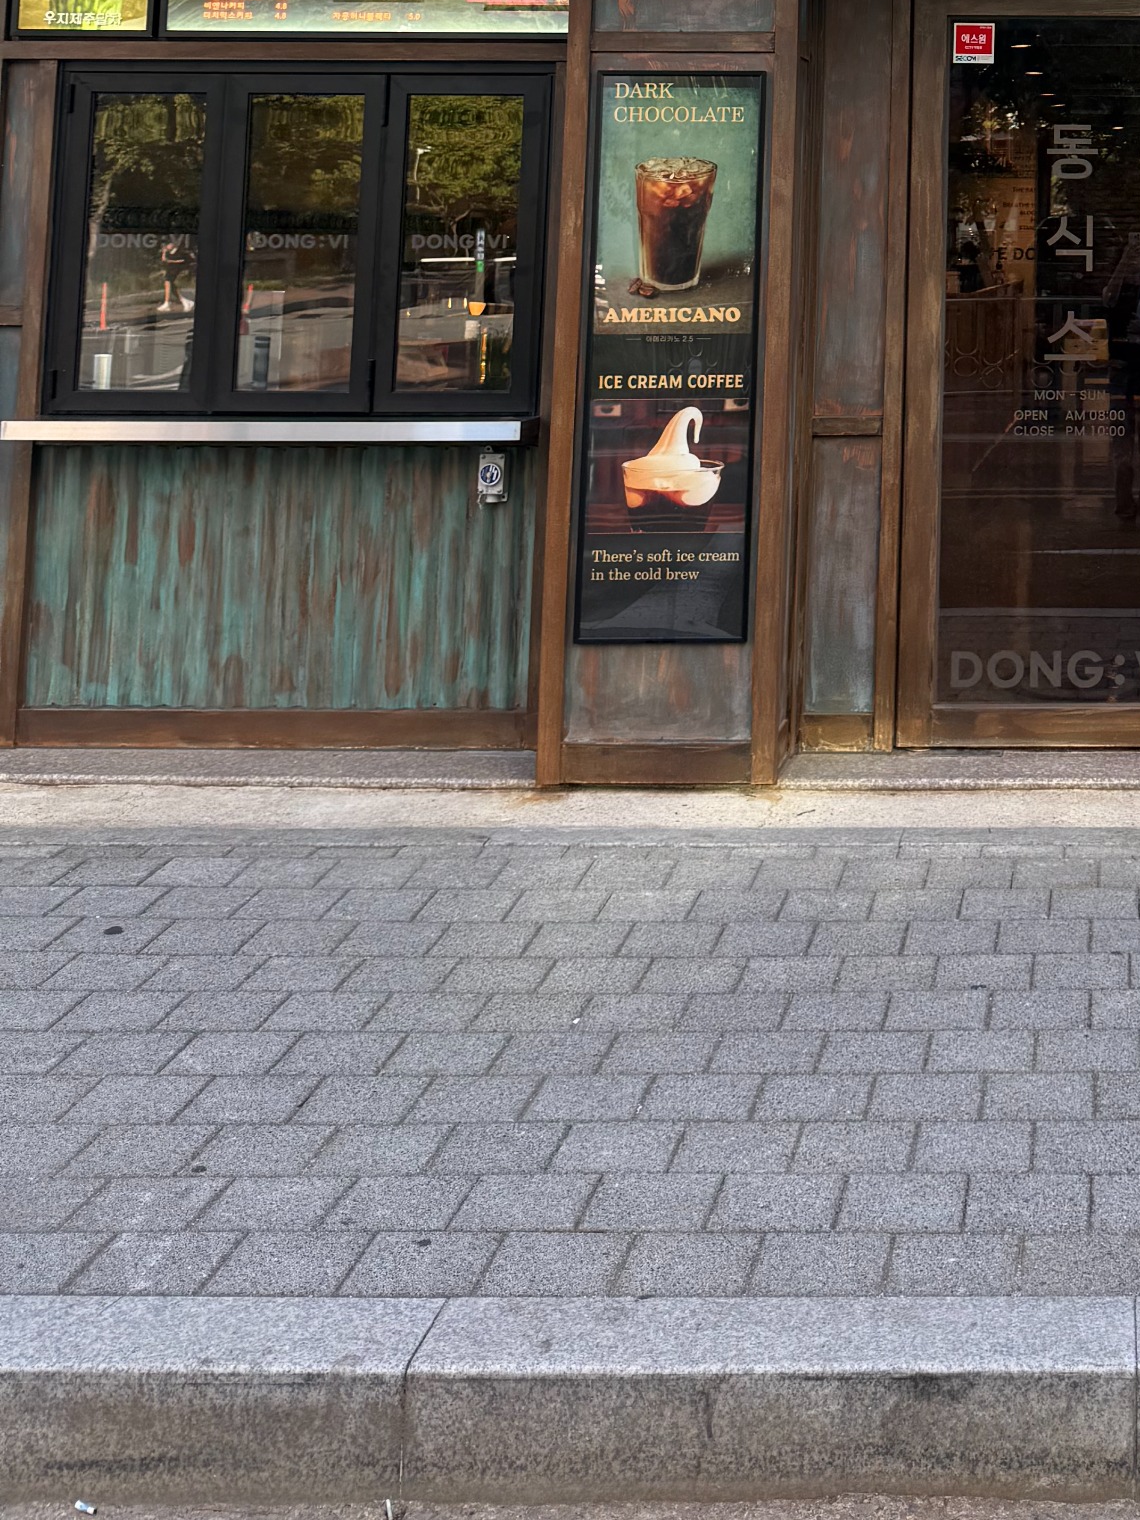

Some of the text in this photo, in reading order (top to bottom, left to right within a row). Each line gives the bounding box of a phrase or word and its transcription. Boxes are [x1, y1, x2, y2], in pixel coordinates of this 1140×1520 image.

[961, 33, 986, 44] 에스원
[614, 82, 674, 99] DARK
[613, 106, 745, 123] CHOCOLATE
[411, 233, 508, 249] DONGVI
[1044, 124, 1099, 361] 동식스
[603, 307, 741, 324] AMERICANO
[645, 335, 694, 343] 아메리카노 2.5
[598, 374, 744, 389] ICE CREAM COFFEE
[1034, 389, 1065, 401] MON
[1080, 389, 1106, 401] SUN
[1014, 410, 1126, 422] OPEN AM 08:00
[1013, 425, 1126, 437] CLOSE PM 10:00
[647, 549, 672, 563] soft
[676, 549, 695, 563] ice
[698, 551, 740, 563] cream
[591, 567, 699, 581] in the cold brew
